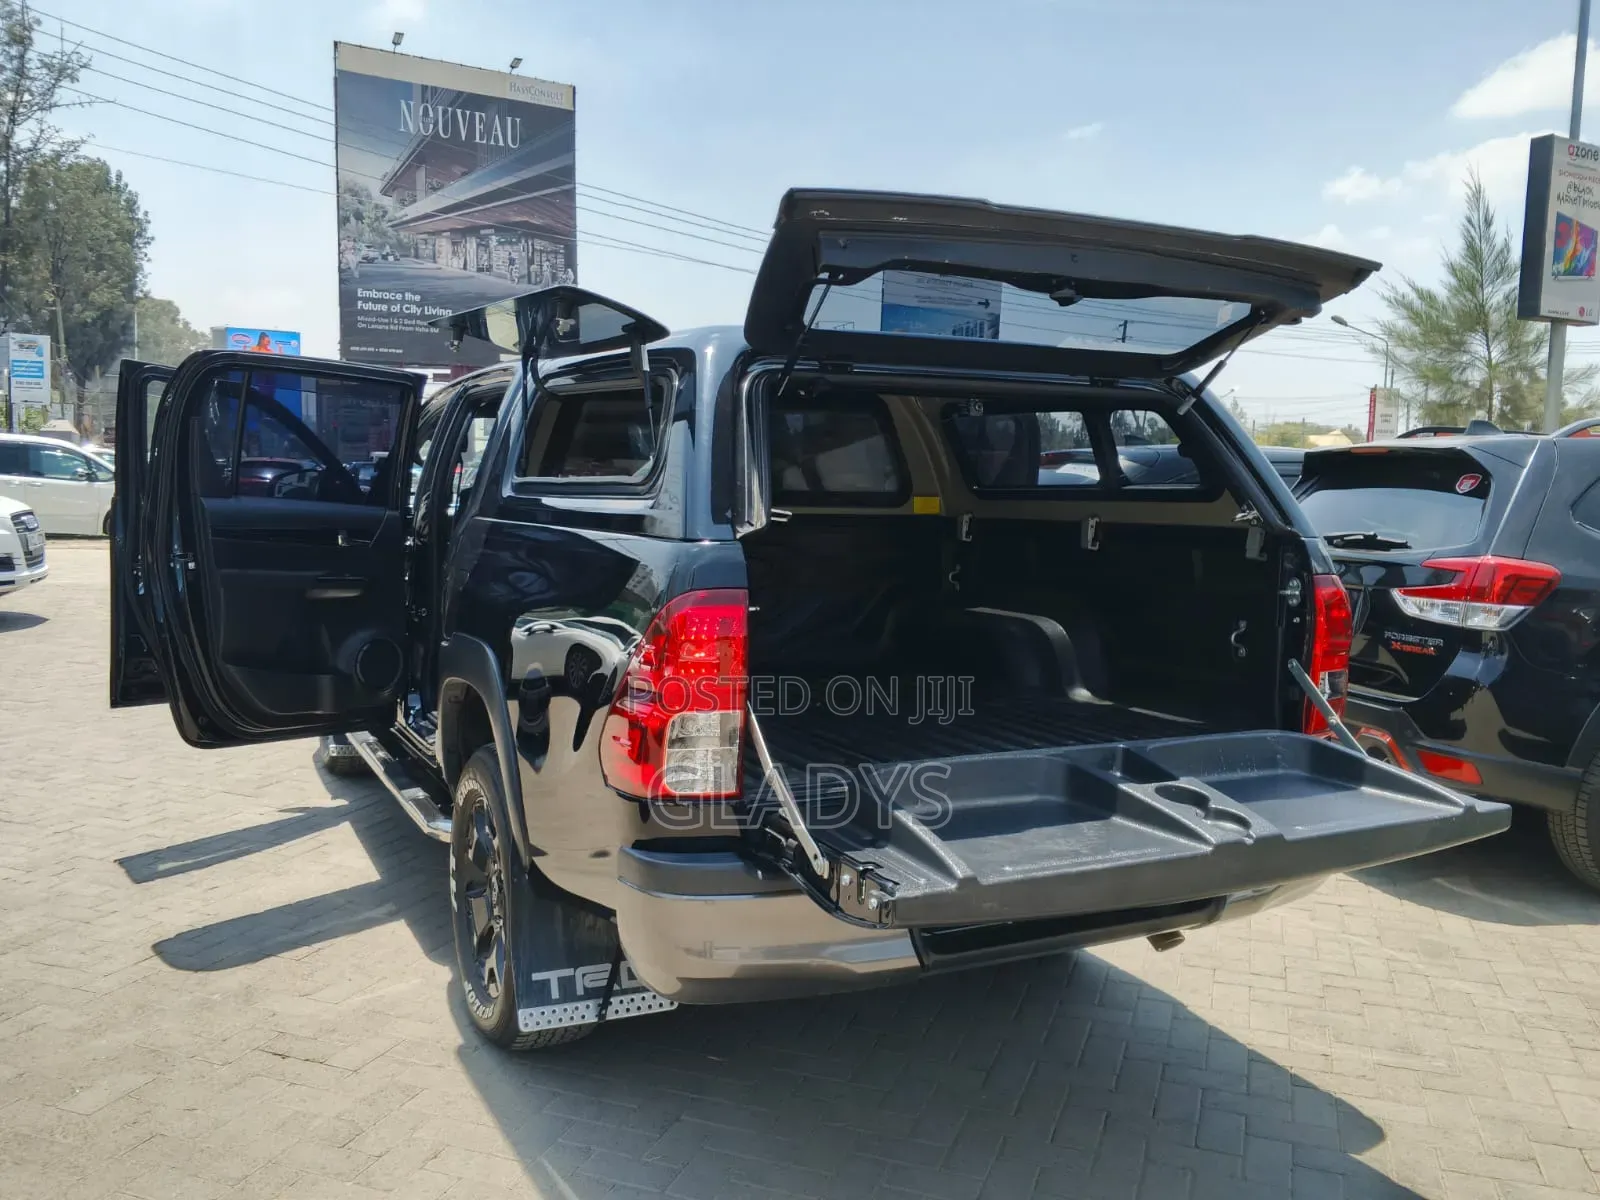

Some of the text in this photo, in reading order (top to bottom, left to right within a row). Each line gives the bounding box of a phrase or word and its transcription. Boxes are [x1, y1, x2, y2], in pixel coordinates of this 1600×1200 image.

[398, 99, 521, 149] NOUVEAU
[1567, 144, 1599, 161] azone
[357, 288, 421, 302] Embrace the
[357, 300, 453, 317] Future of City Living
[1384, 631, 1443, 647] FORESTER
